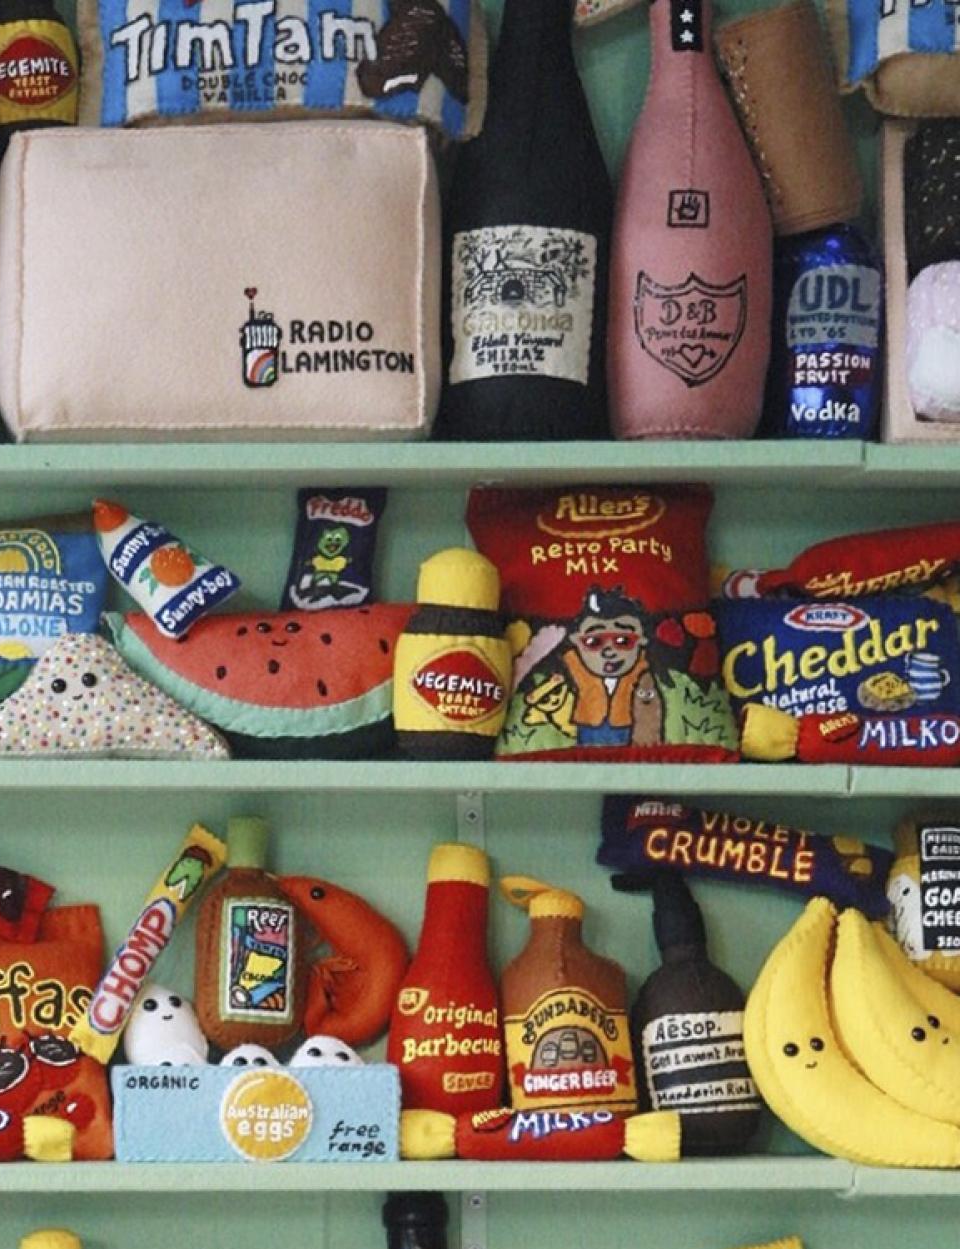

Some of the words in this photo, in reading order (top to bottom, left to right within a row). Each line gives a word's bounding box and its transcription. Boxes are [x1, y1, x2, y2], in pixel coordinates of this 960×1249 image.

[181, 74, 255, 92] DOUBLE
[262, 72, 308, 87] CHOC
[800, 275, 871, 312] UDL
[290, 320, 373, 344] RADIO
[282, 350, 415, 375] LAMINGTON
[796, 353, 870, 369] PASSION
[795, 370, 850, 385] FRUIT
[556, 496, 650, 520] Allen's
[531, 542, 600, 565] Retro
[609, 538, 672, 561] Party
[566, 558, 619, 576] Mix
[29, 576, 96, 593] ROASTED
[723, 618, 938, 698] Cheddar
[416, 671, 501, 700] VEGEMITE
[860, 720, 959, 748] MILKO
[646, 829, 814, 882] CRUMBLE
[93, 908, 167, 1028] CHOMP
[522, 997, 618, 1045] BUNDABERG
[402, 1034, 501, 1064] Barbecue
[126, 1074, 200, 1091] ORGANIC
[524, 1071, 581, 1093] GINGER
[583, 1069, 617, 1089] BEER
[226, 1103, 309, 1122] Australian
[238, 1120, 295, 1143] eggs
[329, 1121, 380, 1142] free
[510, 1111, 612, 1141] MILKO
[328, 1138, 386, 1158] range
